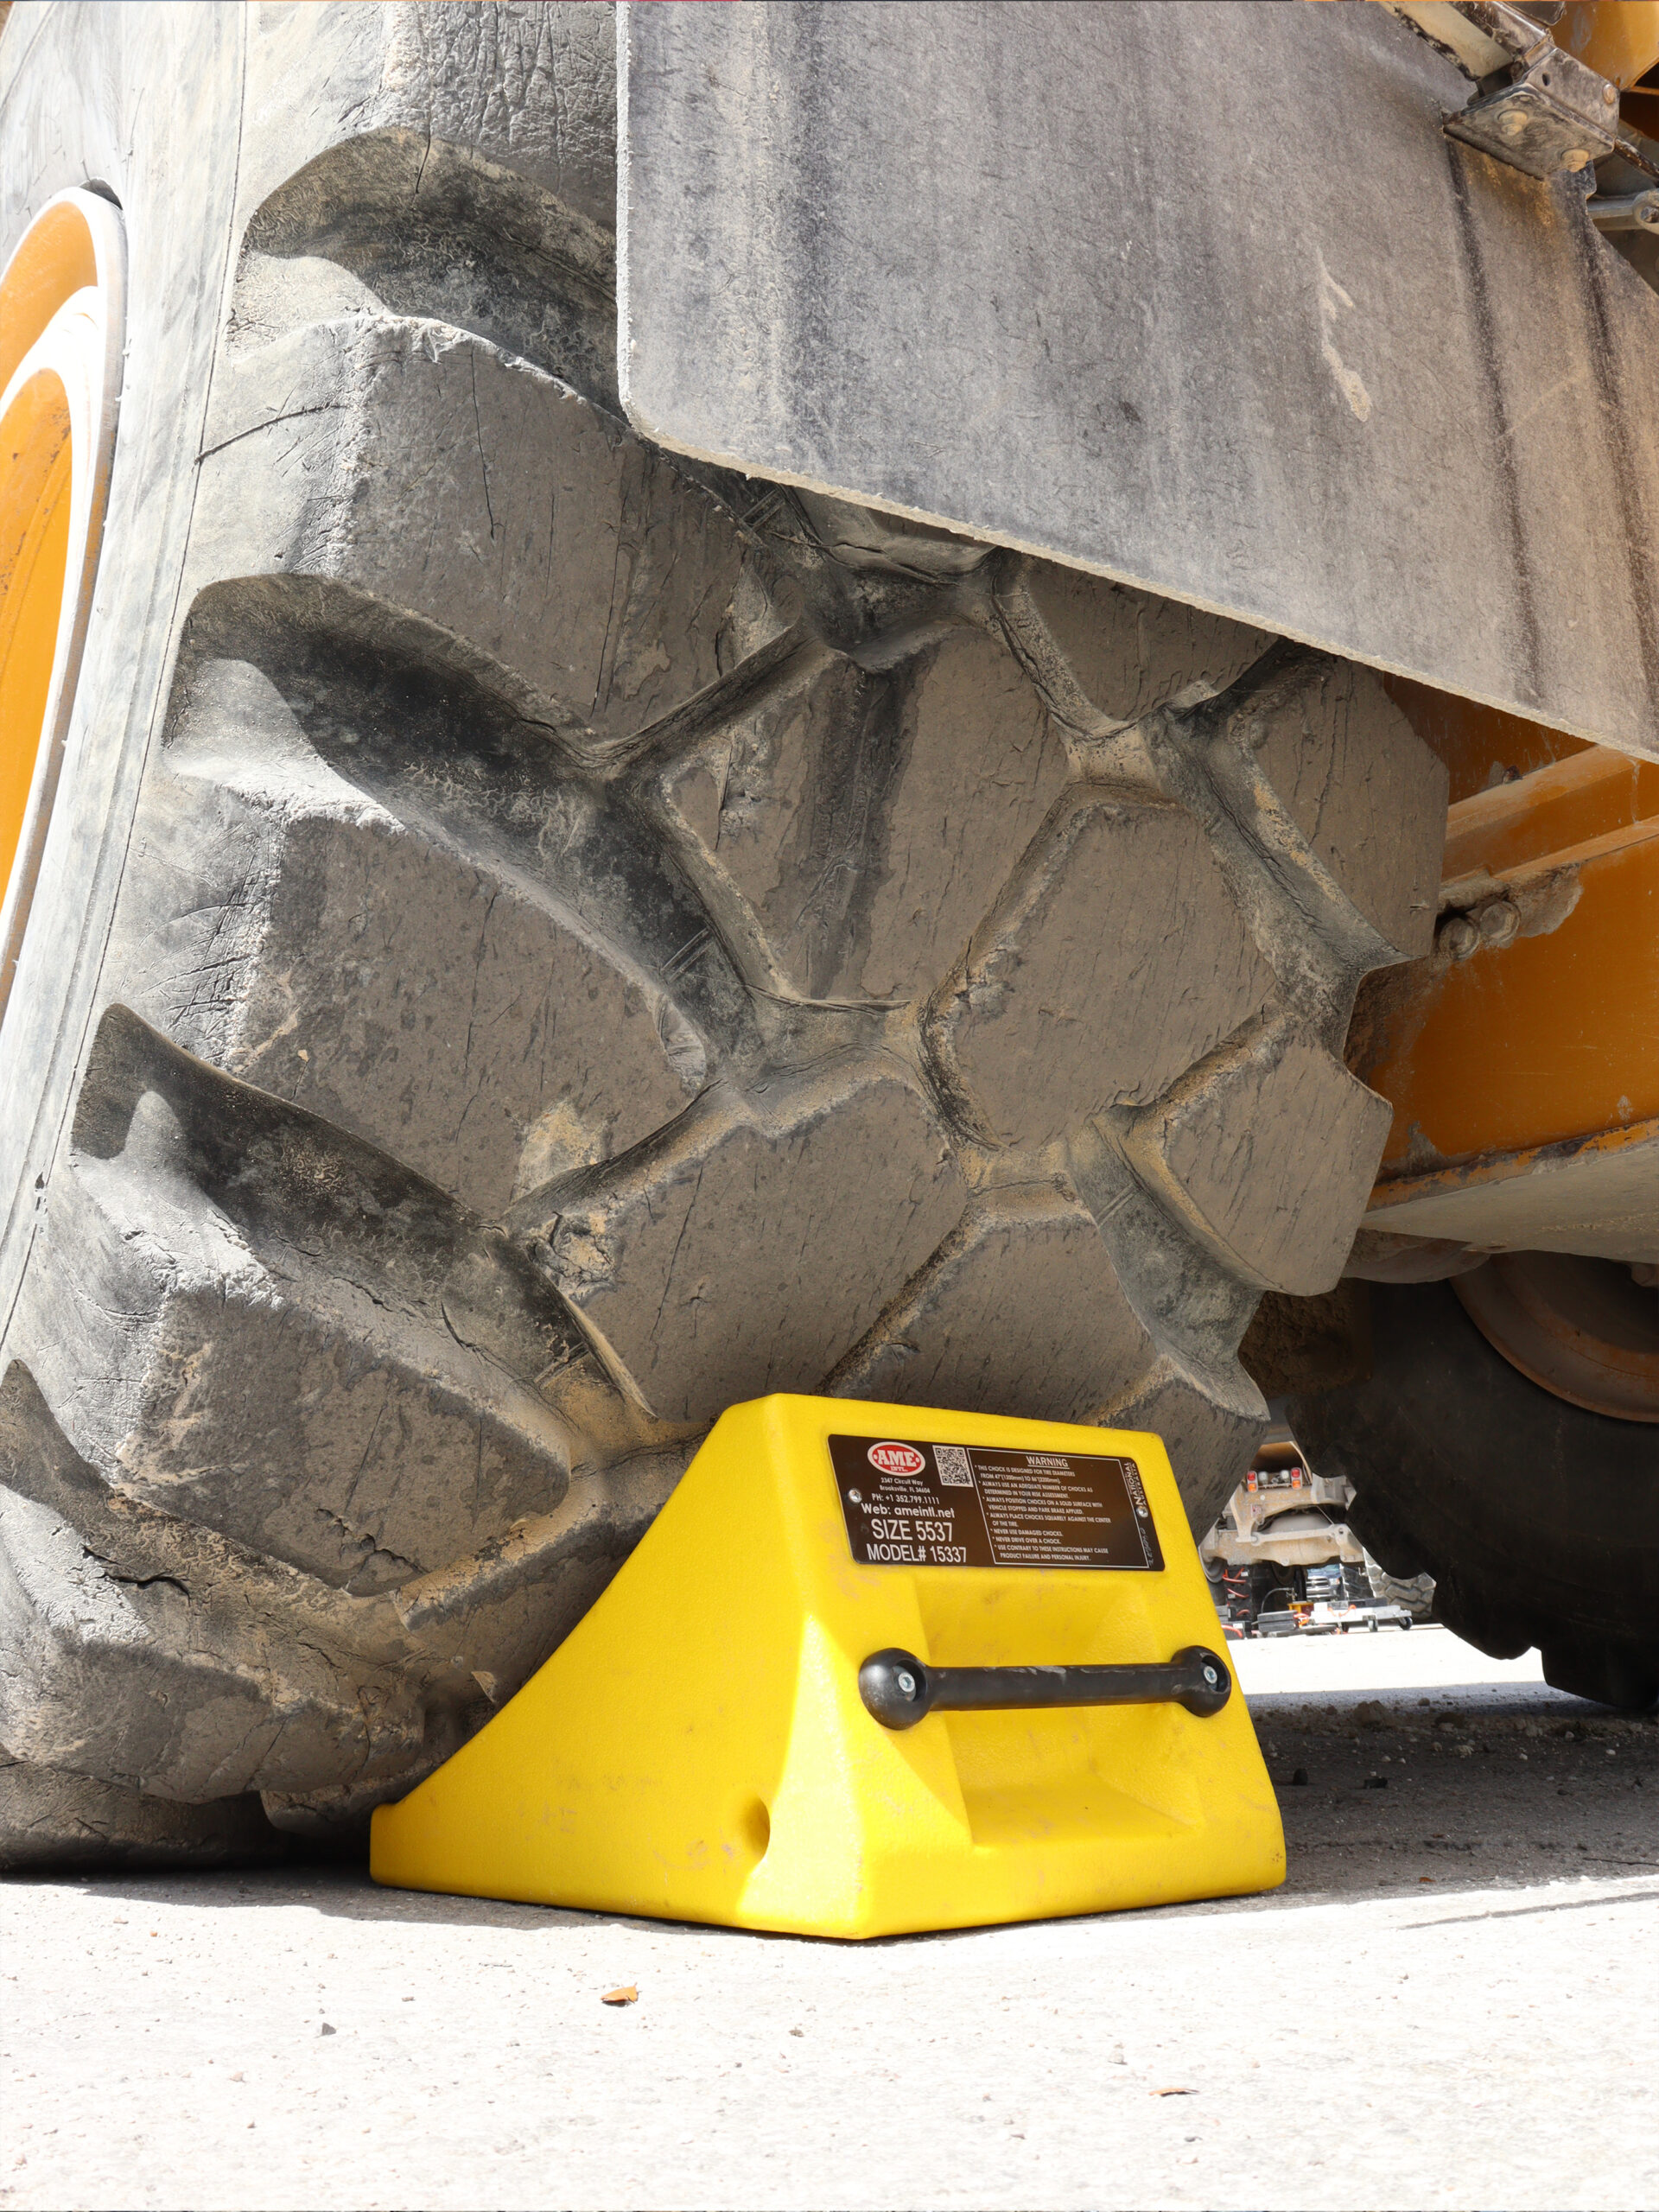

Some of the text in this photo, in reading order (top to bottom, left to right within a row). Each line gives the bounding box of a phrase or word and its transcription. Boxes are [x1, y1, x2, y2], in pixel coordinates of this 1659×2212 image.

[877, 1450, 917, 1467] AME
[1026, 1456, 1068, 1467] WARNING
[1124, 1462, 1143, 1505] NATIONAL
[895, 1495, 939, 1504] 352.799.1111
[861, 1503, 955, 1518] Web: ameintl.net
[871, 1519, 952, 1541] SIZE 5537
[867, 1543, 967, 1562] MODEL# 15337
